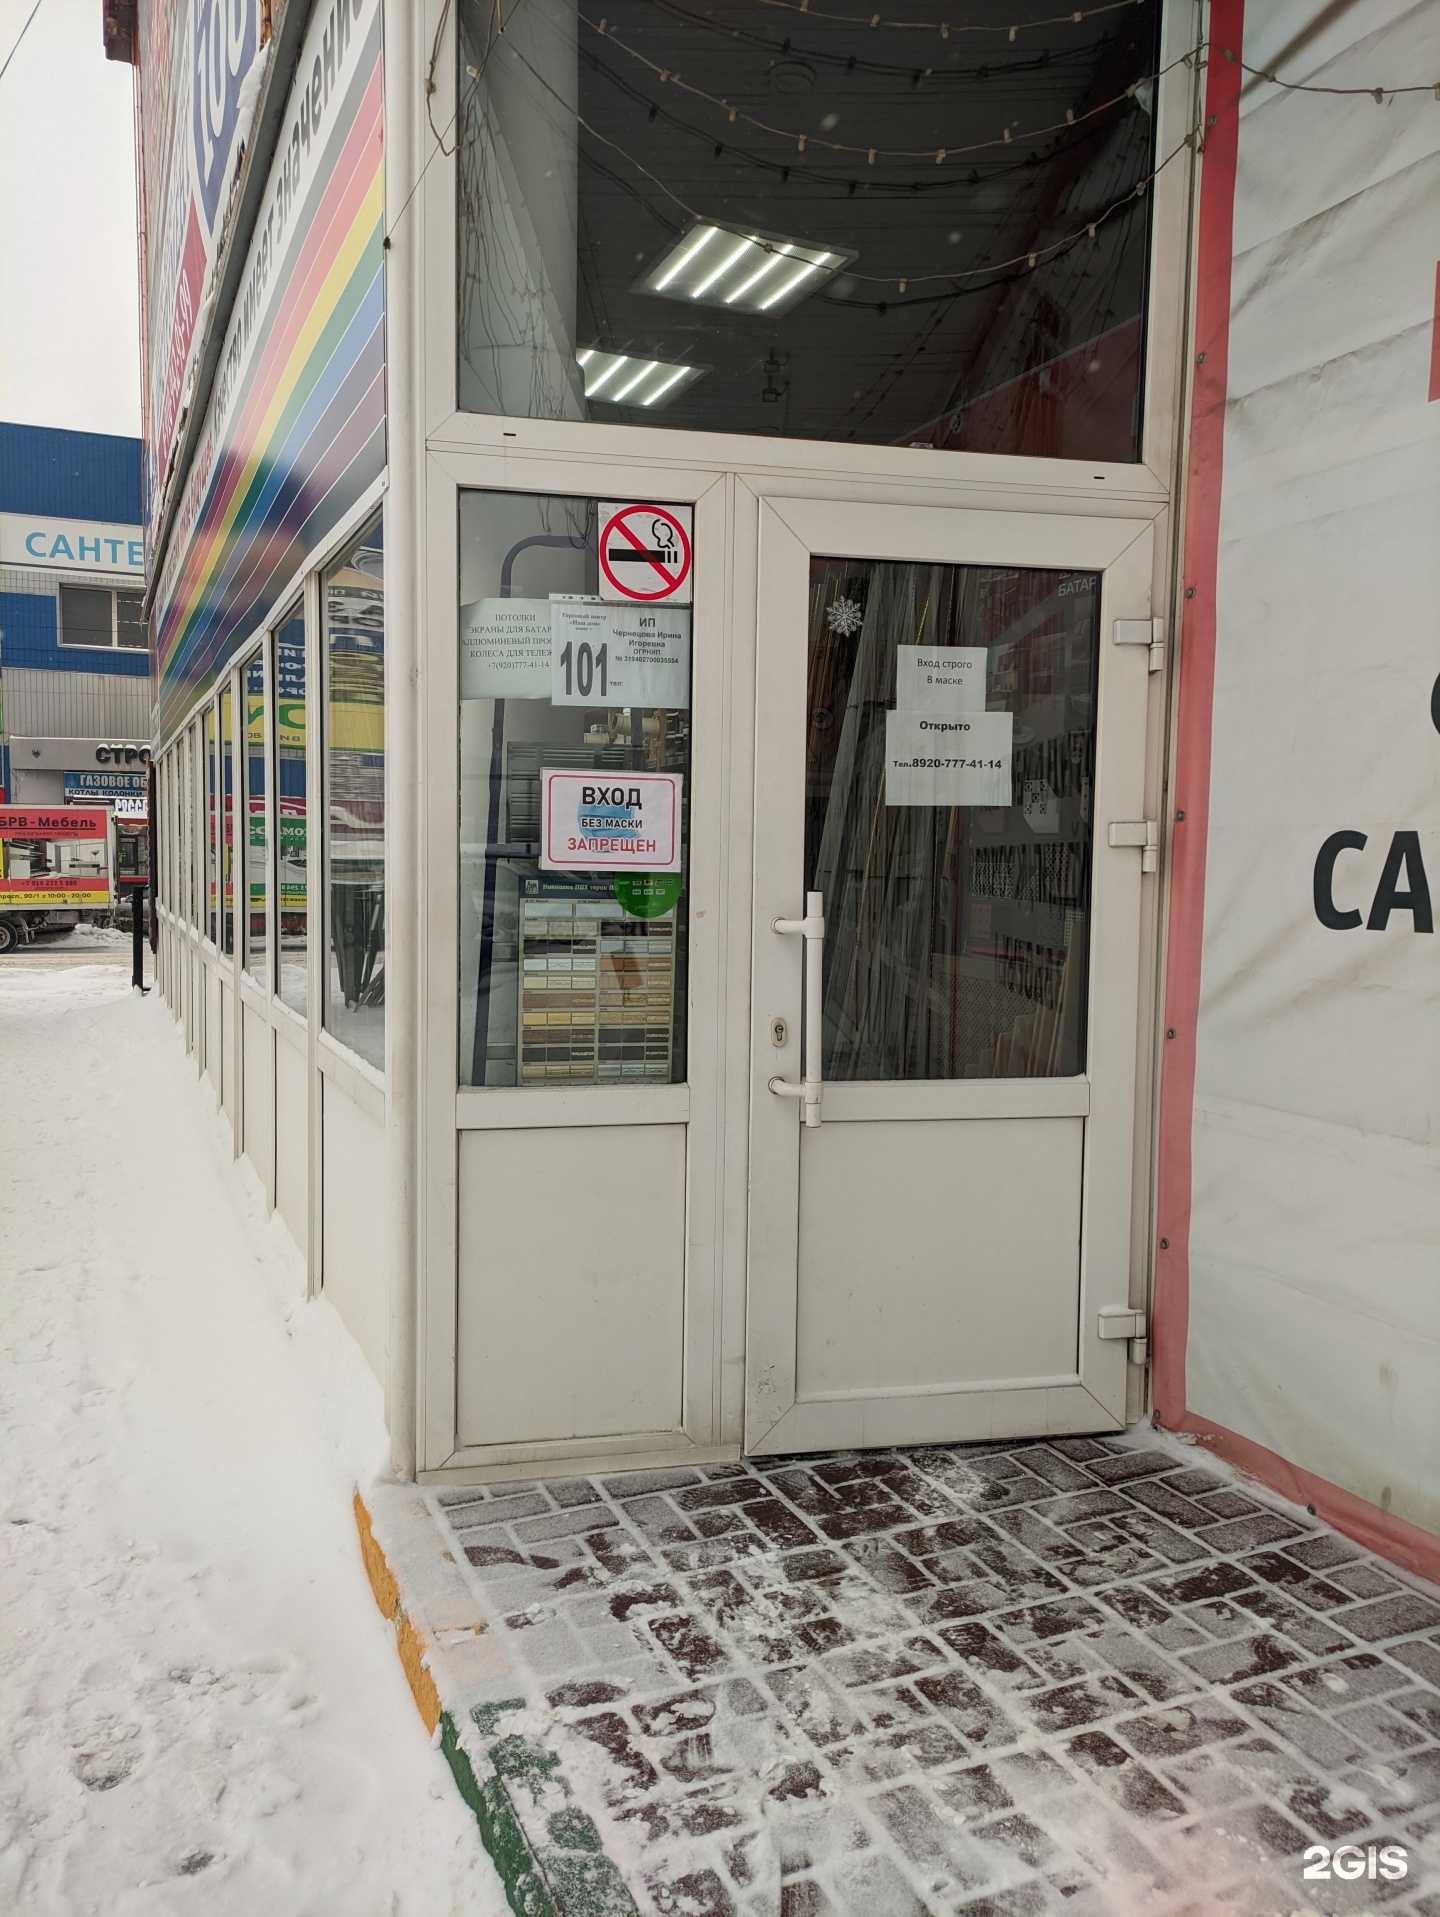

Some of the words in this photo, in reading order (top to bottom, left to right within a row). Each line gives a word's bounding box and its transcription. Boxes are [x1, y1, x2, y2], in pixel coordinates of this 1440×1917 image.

[25, 531, 143, 565] САНТЕ
[495, 613, 536, 622] ПОТОЛКИ
[639, 617, 656, 627] ИП
[506, 626, 524, 634] ДЛЯ
[657, 631, 682, 639] Ирина
[470, 649, 504, 658] КОЛЕСА
[506, 649, 524, 658] ДЛЯ
[560, 641, 608, 697] 101
[917, 657, 940, 669] Вход
[942, 660, 973, 670] строго
[935, 677, 964, 685] маске
[919, 720, 971, 732] Открыто
[80, 774, 130, 788] ГАЗОВОЕ
[582, 787, 642, 810] ВХОД
[581, 818, 603, 828] БЕЗ
[604, 818, 643, 829] МАСКИ
[567, 837, 656, 854] ЗАПРЕЩЕН
